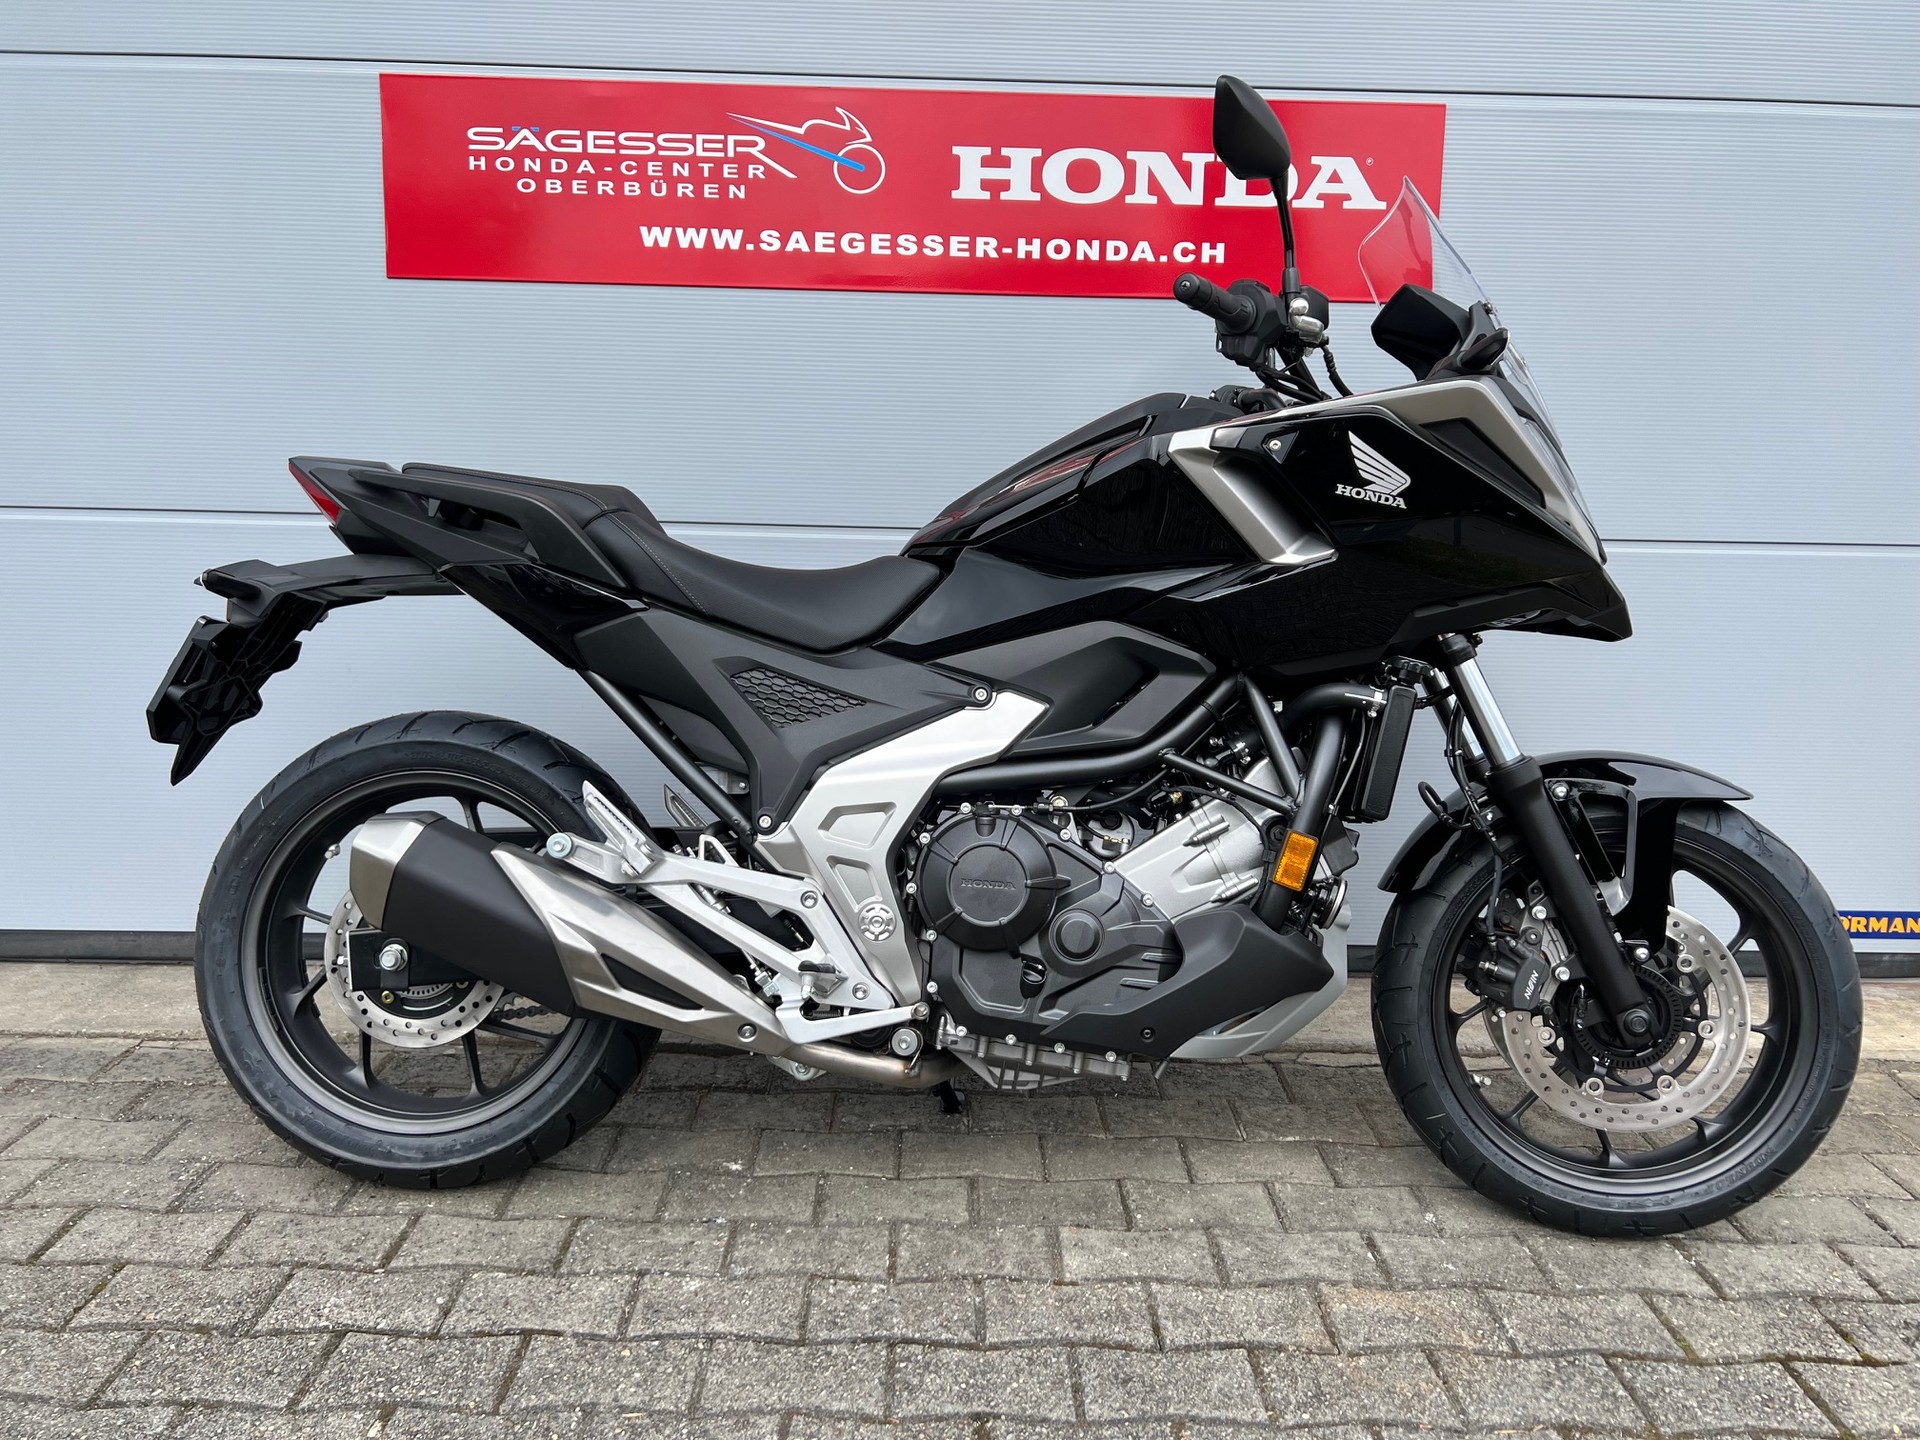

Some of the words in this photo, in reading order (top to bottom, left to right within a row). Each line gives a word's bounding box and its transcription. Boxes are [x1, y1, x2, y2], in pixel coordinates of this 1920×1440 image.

[467, 125, 798, 179] SÄGESSER
[469, 155, 766, 179] HONDA-CENTER
[951, 145, 1387, 210] HONDA
[516, 178, 746, 199] OBERBÜREN
[639, 226, 1225, 264] WWW.SAEGESSER-HONDA.CH
[1334, 483, 1407, 509] HONDA
[960, 878, 1017, 891] HONDA
